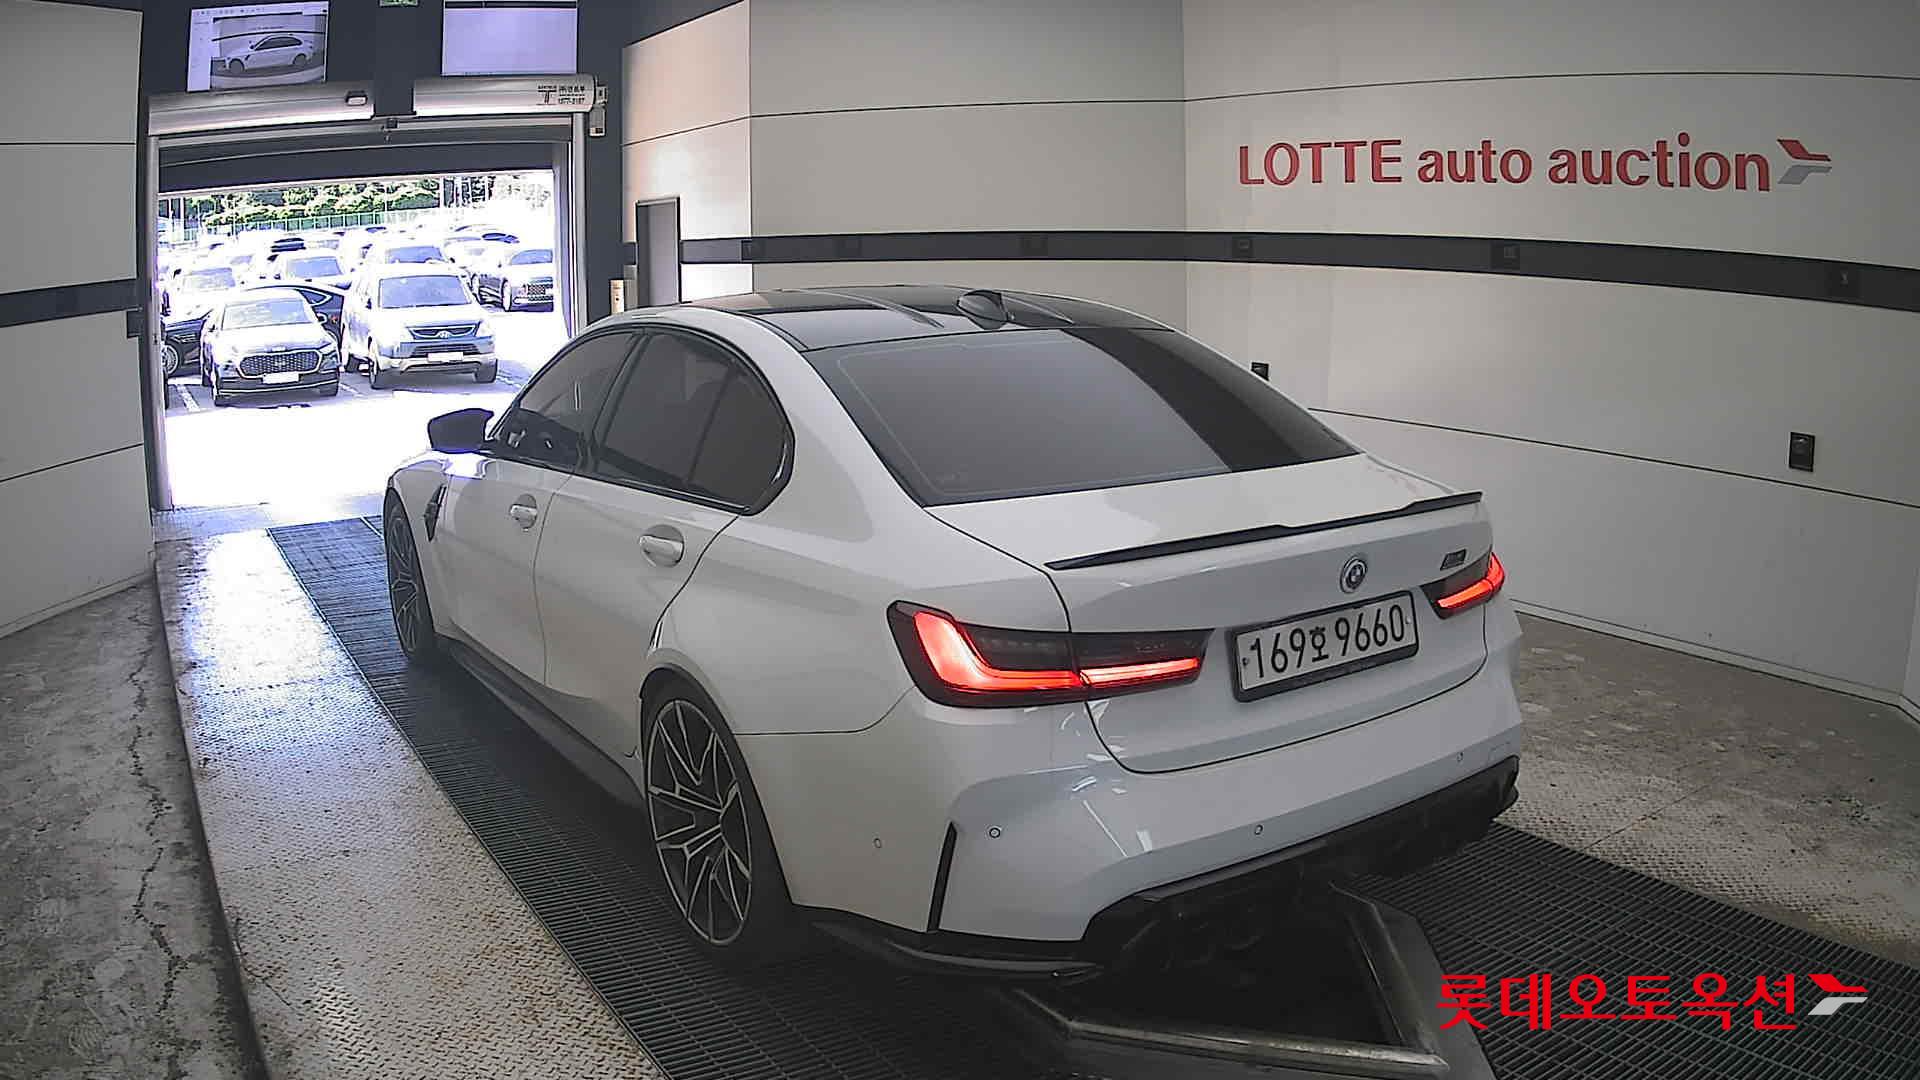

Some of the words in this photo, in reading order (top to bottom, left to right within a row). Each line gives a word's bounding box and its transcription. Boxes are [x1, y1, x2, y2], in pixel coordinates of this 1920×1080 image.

[1239, 139, 1401, 185] LOTTE
[1417, 140, 1532, 184] auto
[1549, 132, 1770, 192] auction
